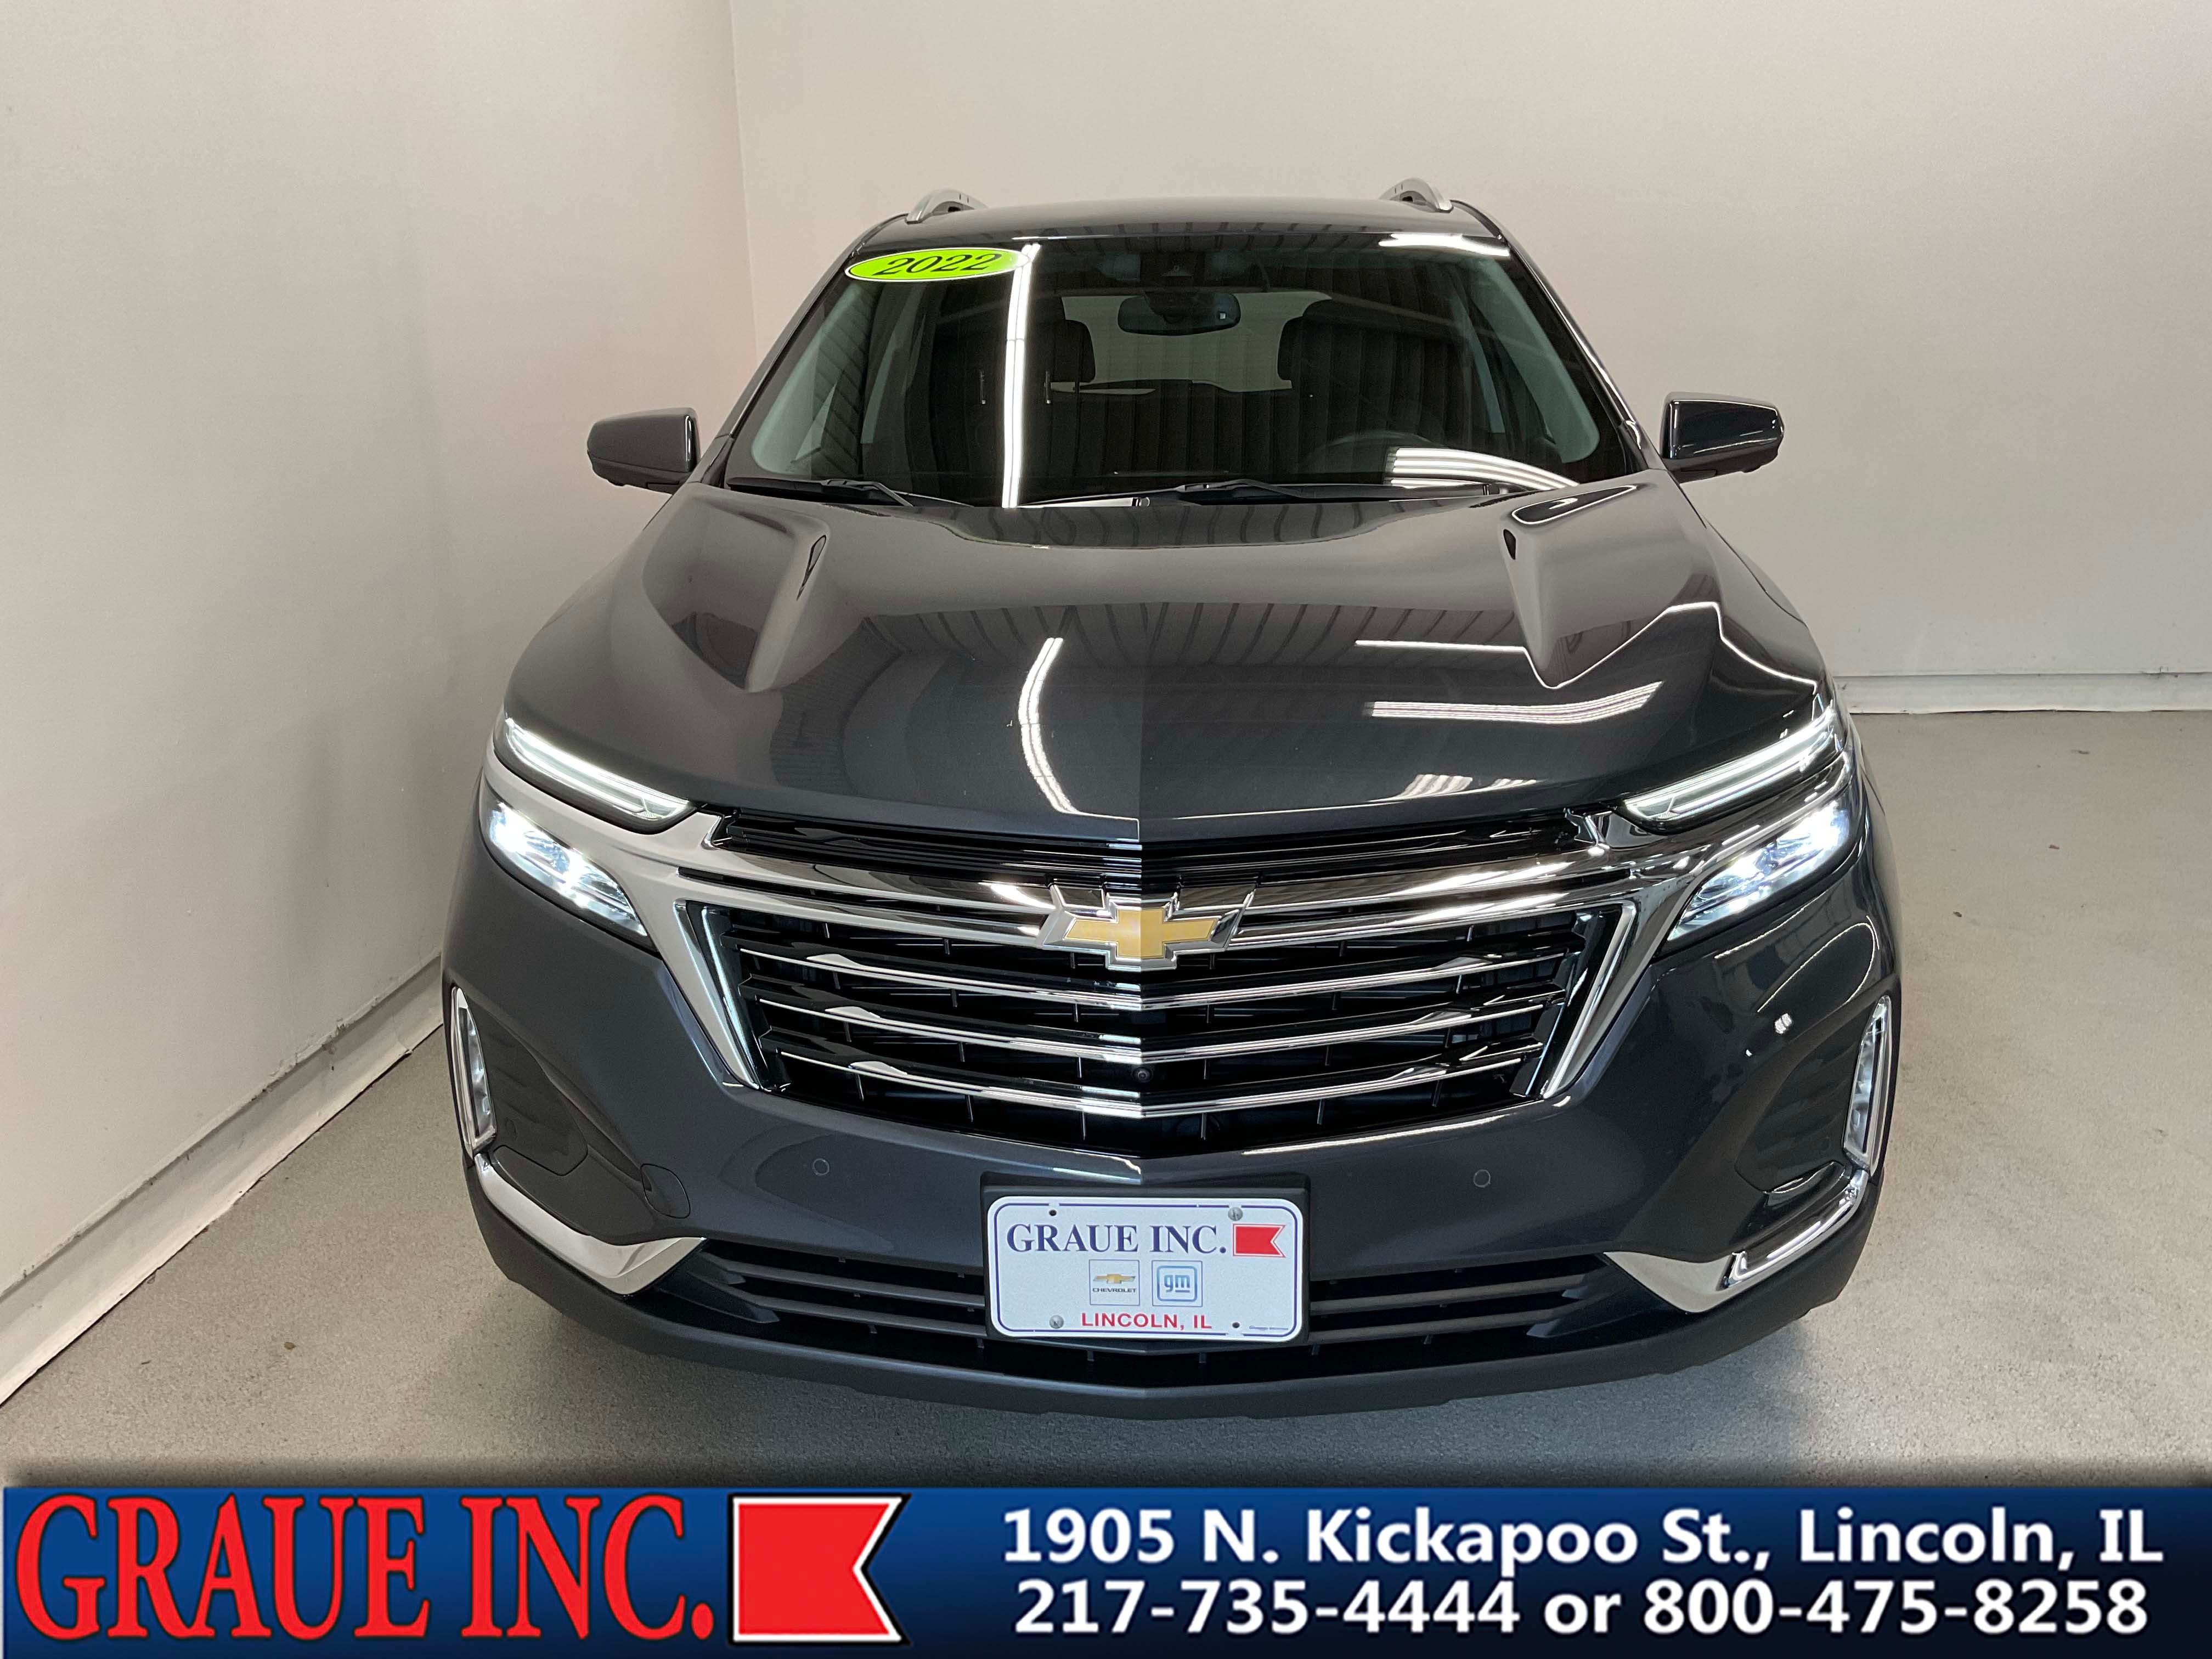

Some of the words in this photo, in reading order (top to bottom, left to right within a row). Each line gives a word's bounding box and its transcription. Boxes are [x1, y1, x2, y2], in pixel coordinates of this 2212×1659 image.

[872, 253, 1002, 275] 2022
[1007, 1224, 1138, 1252] GRAUE
[1150, 1225, 1226, 1254] INC.
[1164, 1274, 1190, 1293] gm
[1082, 1313, 1184, 1330] LINCOLN,
[1193, 1316, 1212, 1329] IL
